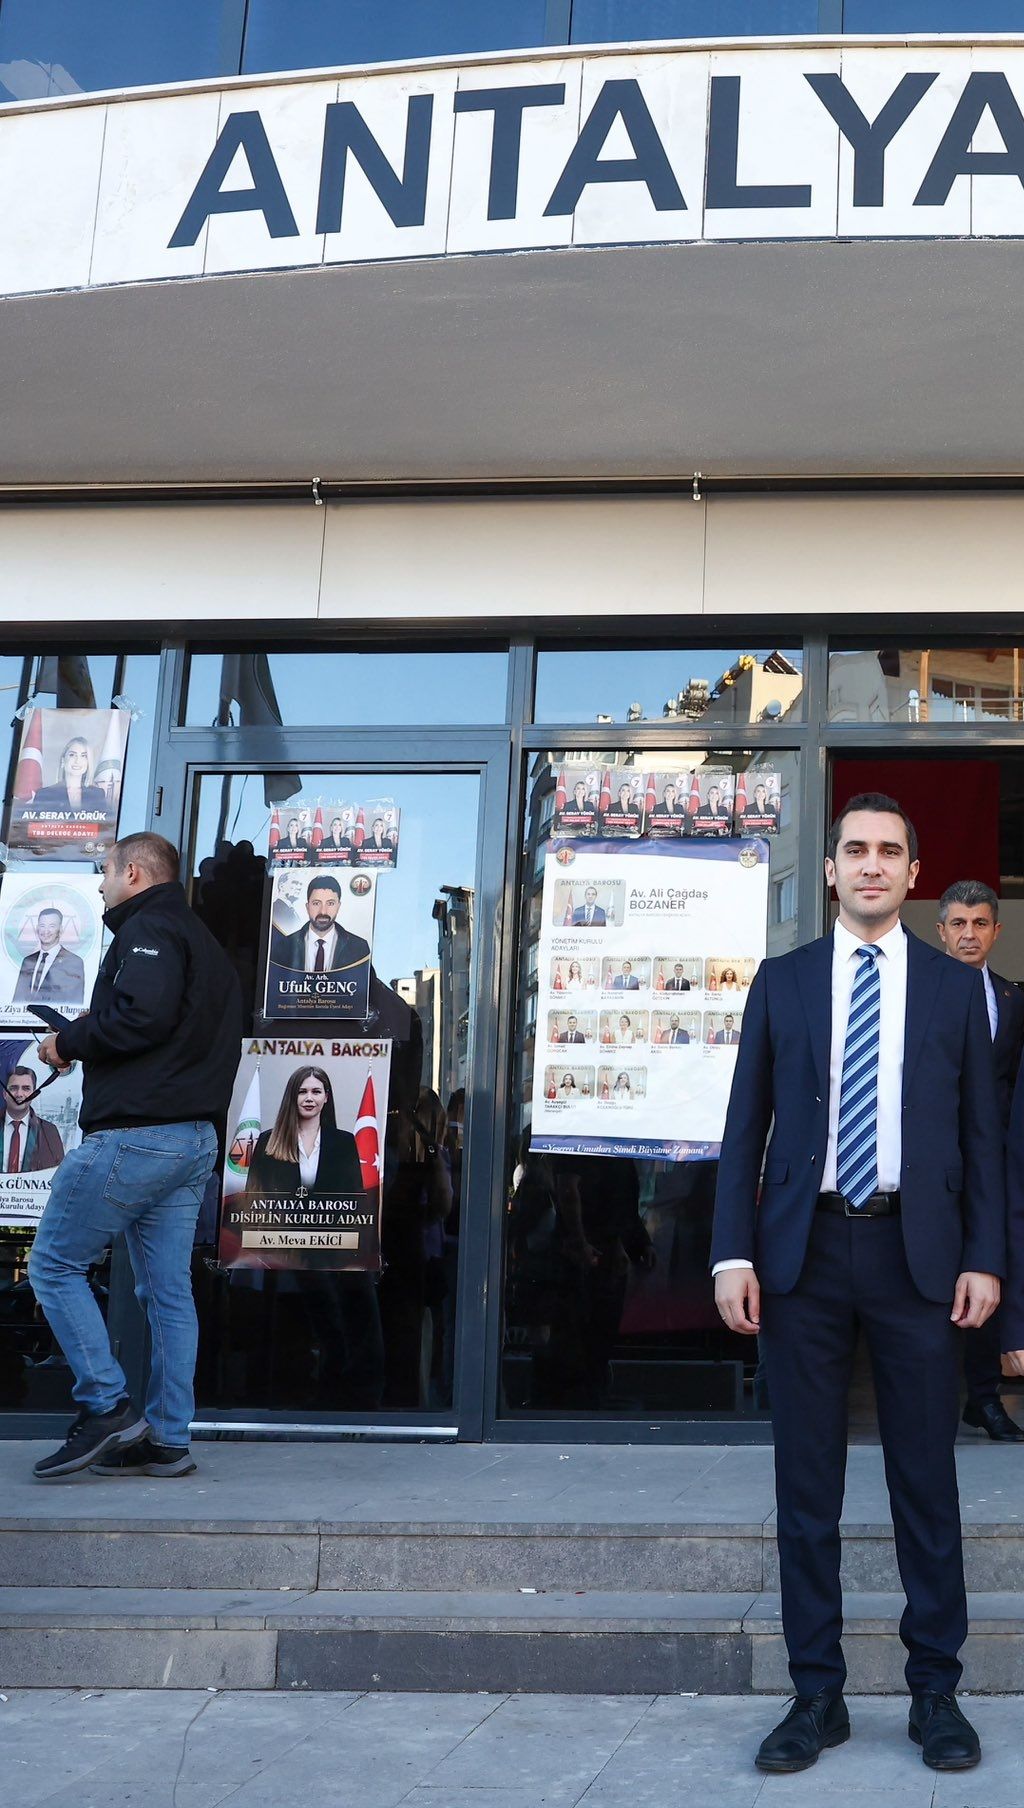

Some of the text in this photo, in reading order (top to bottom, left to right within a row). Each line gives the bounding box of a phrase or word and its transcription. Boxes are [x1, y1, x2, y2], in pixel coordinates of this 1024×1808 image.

[21, 810, 107, 821] AV. SERAY YÖRÜK
[629, 888, 709, 900] Av. Ali Çağdaş
[629, 900, 685, 910] BOZANER
[279, 980, 357, 996] Ufuk GENÇ
[4, 1005, 21, 1014] Ziya
[247, 1039, 389, 1057] ANTALYA BAROSU
[25, 1203, 45, 1211] Adayı
[250, 1199, 358, 1211] ANTALYA BAROSU
[230, 1210, 374, 1225] DİSİPLİN KURULU ADAYI
[259, 1233, 342, 1246] Av. Meva EKİCİ
